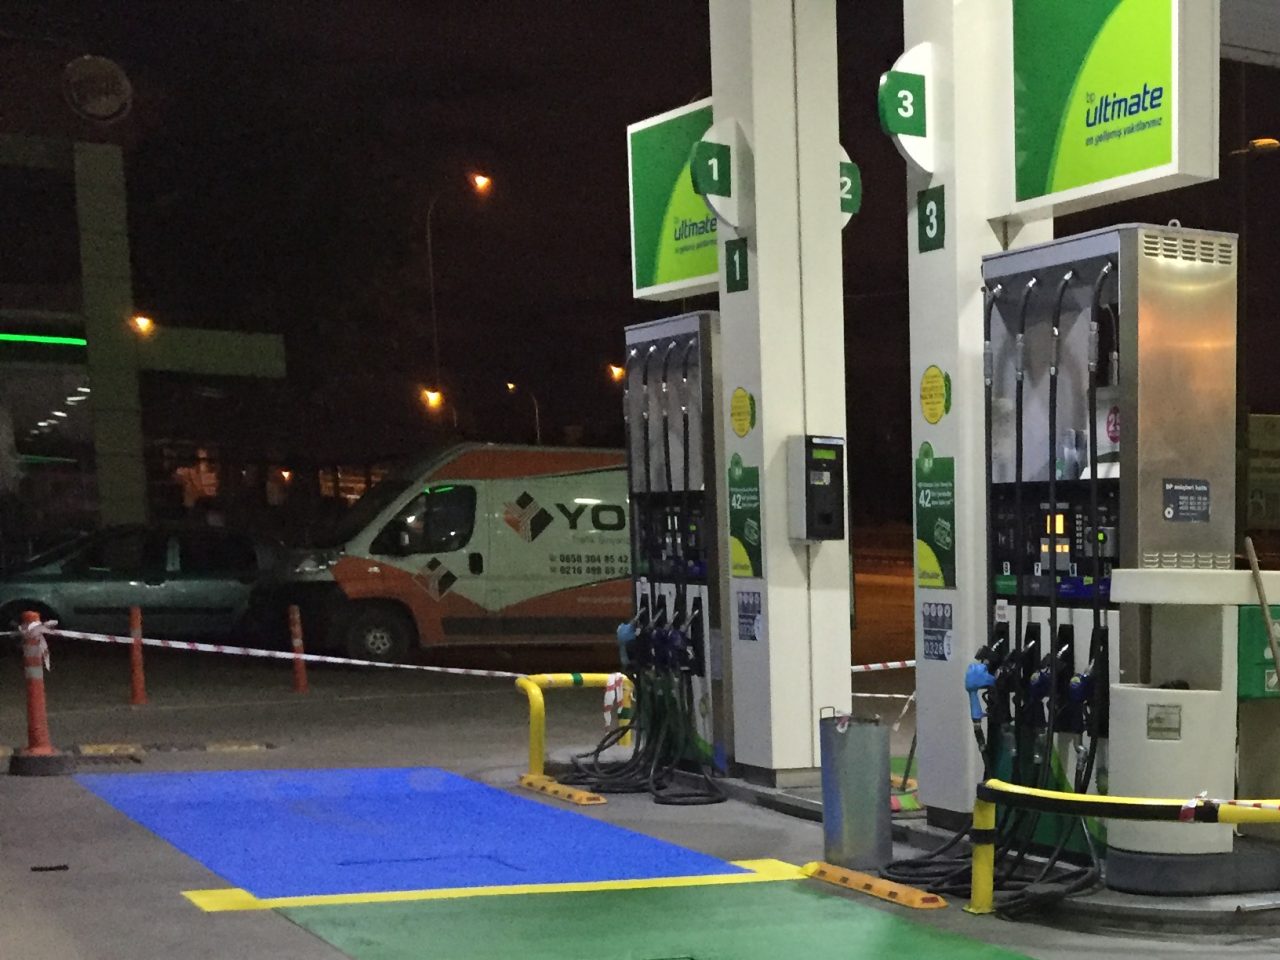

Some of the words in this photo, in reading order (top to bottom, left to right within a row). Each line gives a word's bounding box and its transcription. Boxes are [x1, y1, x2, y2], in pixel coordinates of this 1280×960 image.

[897, 90, 914, 118] 3
[1085, 83, 1164, 128] ultimate
[708, 158, 719, 181] 1
[840, 177, 852, 199] 2
[674, 216, 718, 241] ultimate
[926, 201, 938, 239] 3
[733, 250, 741, 281] 1
[732, 494, 742, 510] 42
[919, 489, 931, 508] 42
